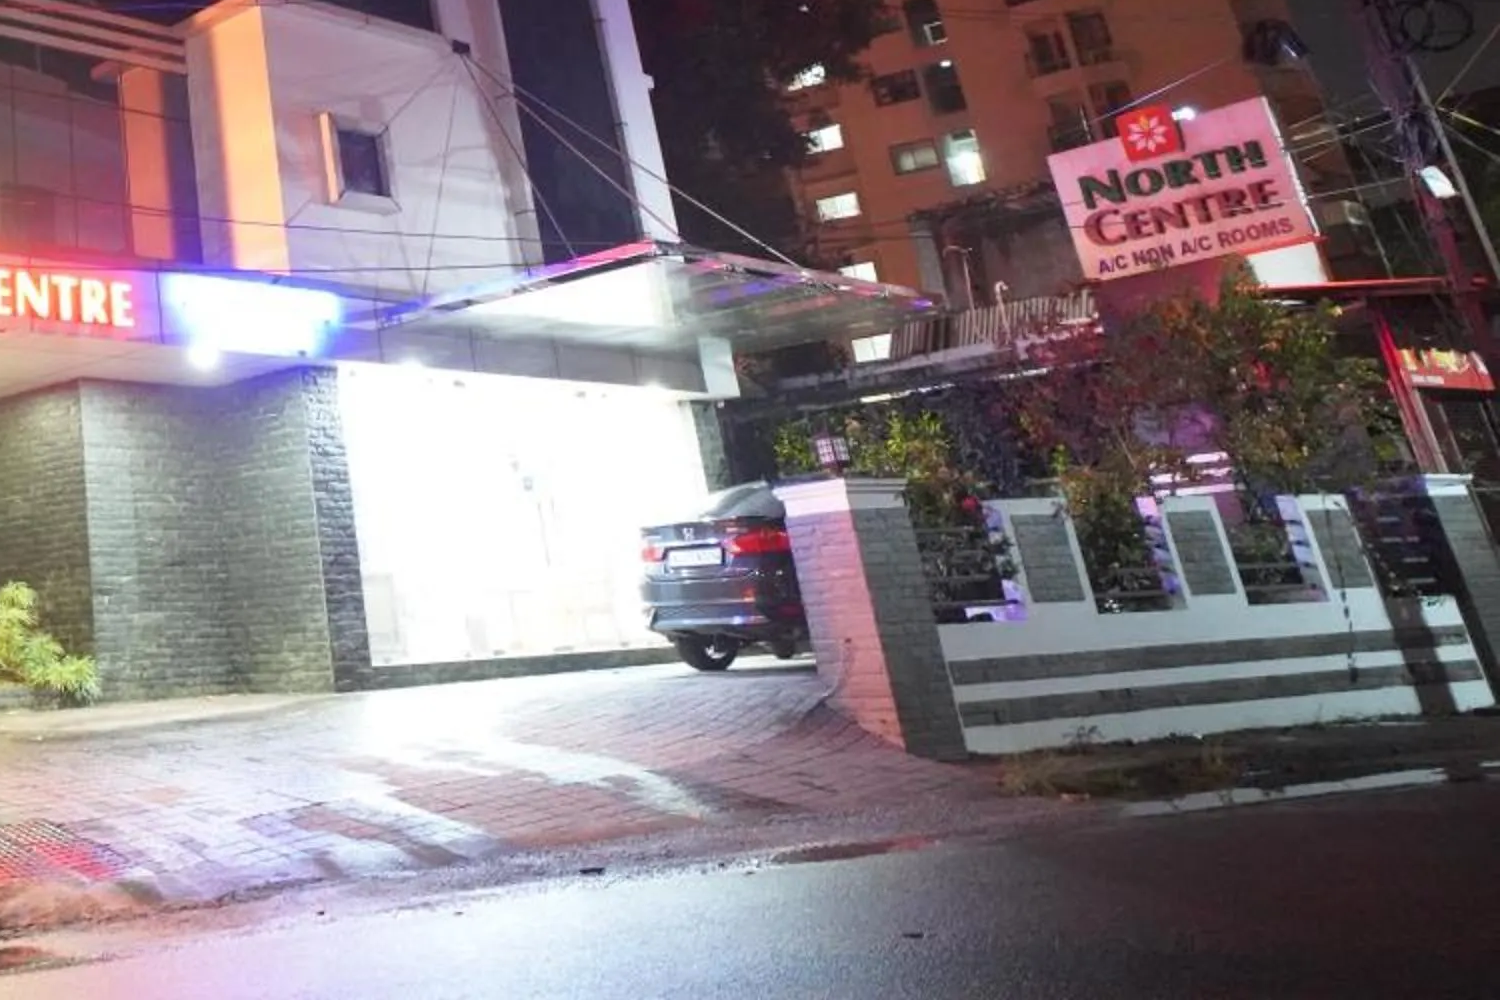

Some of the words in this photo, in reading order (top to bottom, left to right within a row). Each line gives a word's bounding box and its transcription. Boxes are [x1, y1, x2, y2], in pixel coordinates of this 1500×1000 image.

[1077, 139, 1269, 210] NORTH
[1083, 179, 1285, 247] CENTRE
[1098, 253, 1129, 274] A/C
[1180, 235, 1213, 257] A/C
[1217, 217, 1295, 249] ROOMS
